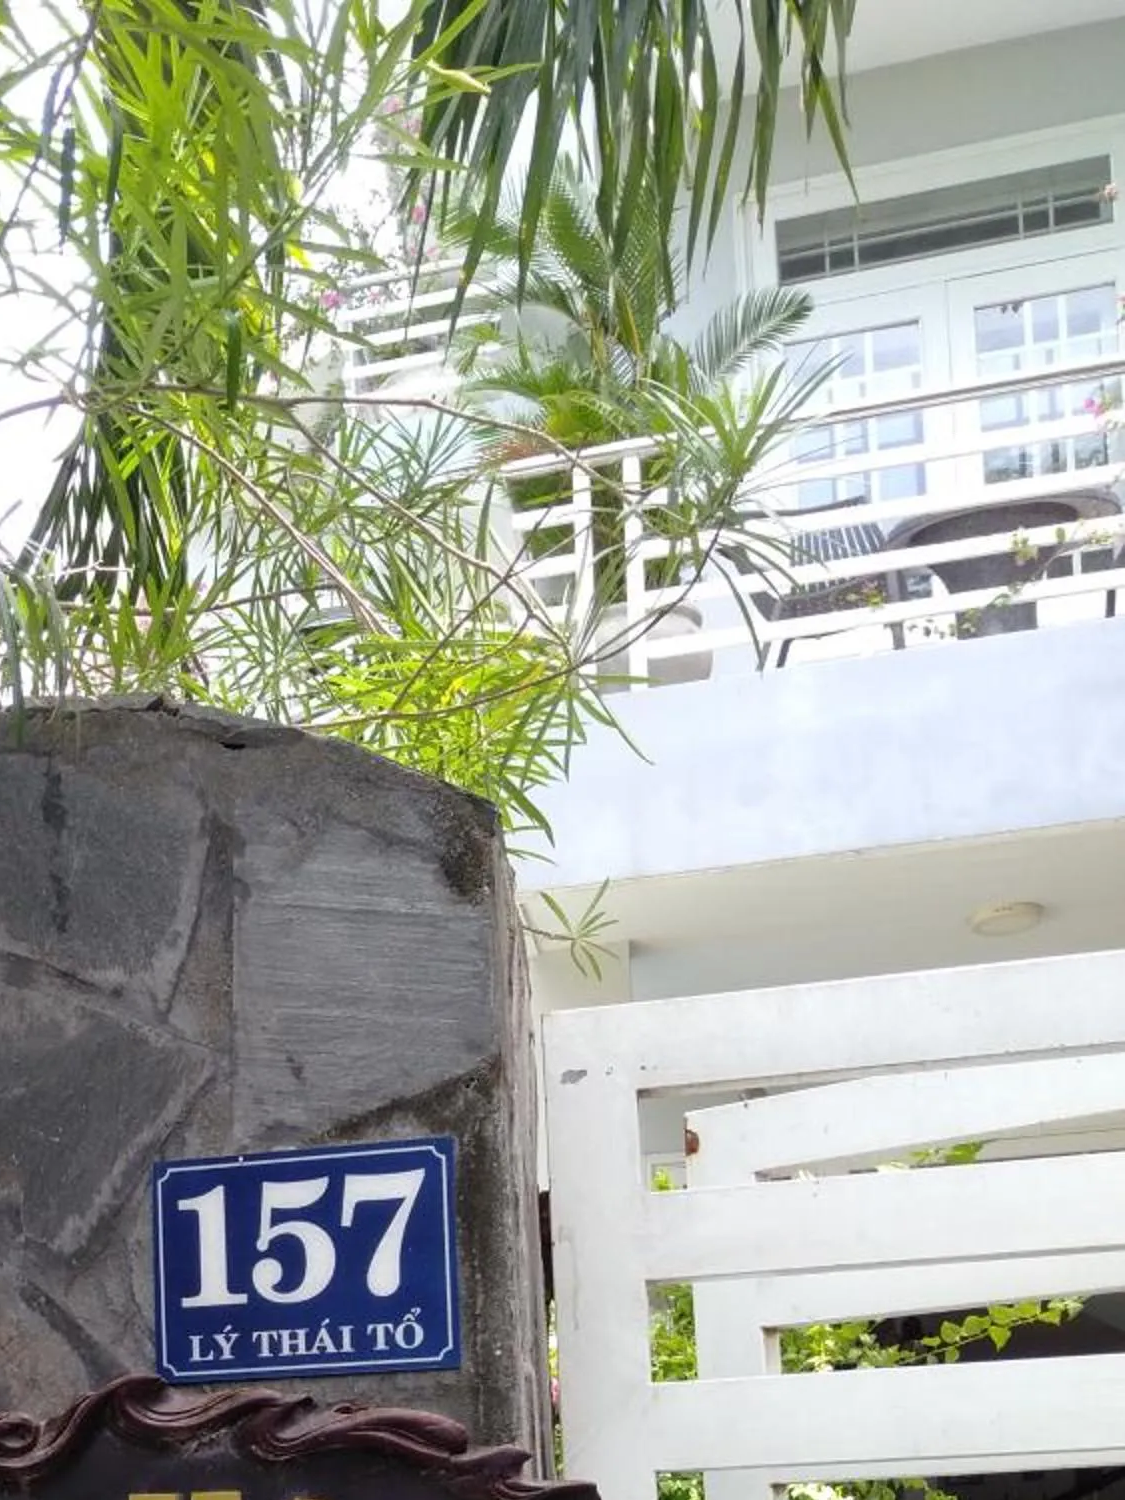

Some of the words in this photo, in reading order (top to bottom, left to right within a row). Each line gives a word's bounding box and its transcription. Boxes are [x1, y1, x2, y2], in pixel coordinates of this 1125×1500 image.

[177, 1168, 425, 1308] 157
[189, 1325, 240, 1362] LÝ
[252, 1318, 356, 1358] THÁI
[366, 1307, 424, 1351] TỔ
